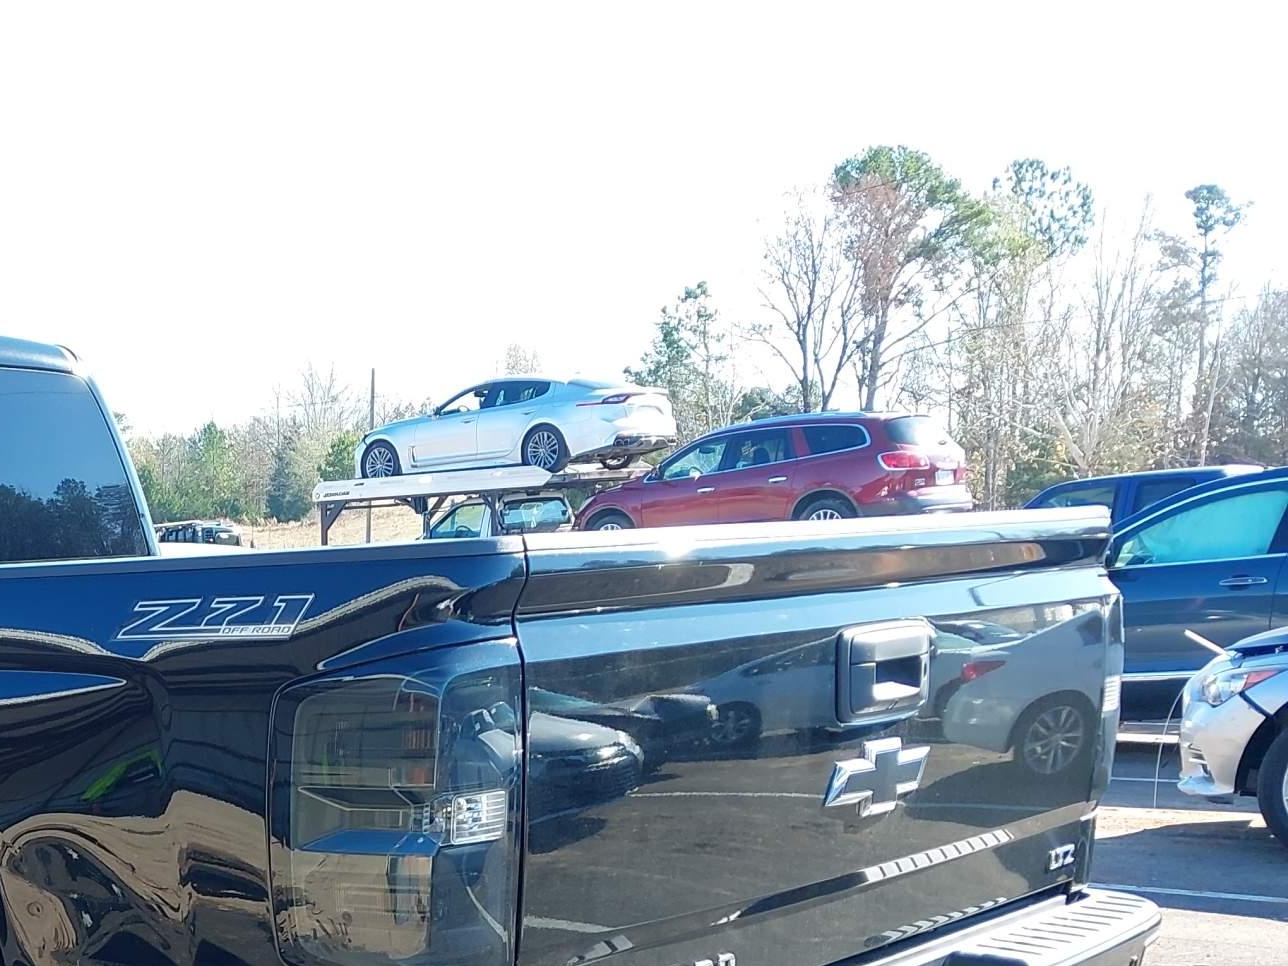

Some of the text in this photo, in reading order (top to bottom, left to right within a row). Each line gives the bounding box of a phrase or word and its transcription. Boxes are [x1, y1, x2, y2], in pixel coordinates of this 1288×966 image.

[116, 593, 315, 639] Z71
[222, 626, 292, 634] OFF ROAD
[1048, 843, 1075, 870] LTZ
